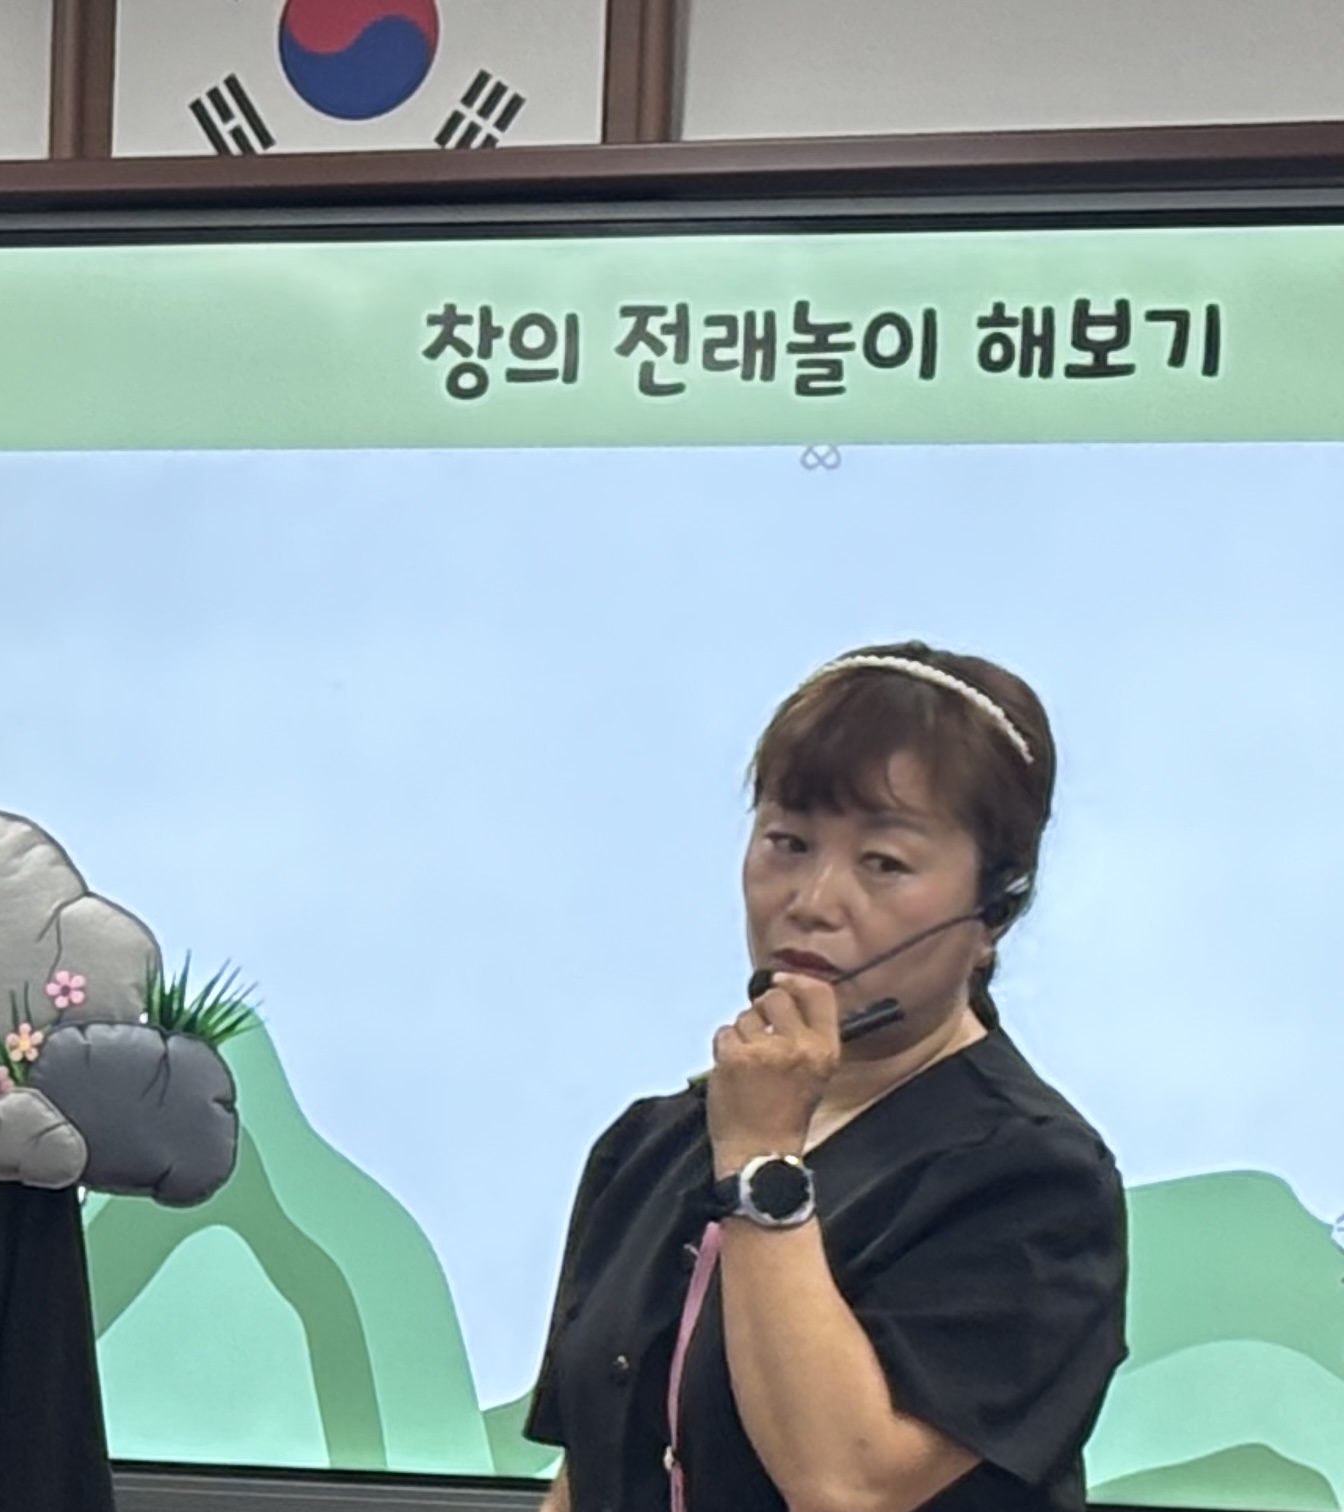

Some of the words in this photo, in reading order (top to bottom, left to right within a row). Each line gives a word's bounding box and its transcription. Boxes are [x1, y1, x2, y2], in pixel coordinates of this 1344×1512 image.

[421, 302, 580, 400] 창의
[614, 299, 939, 398] 전래놀이
[976, 297, 1223, 380] 해보기
